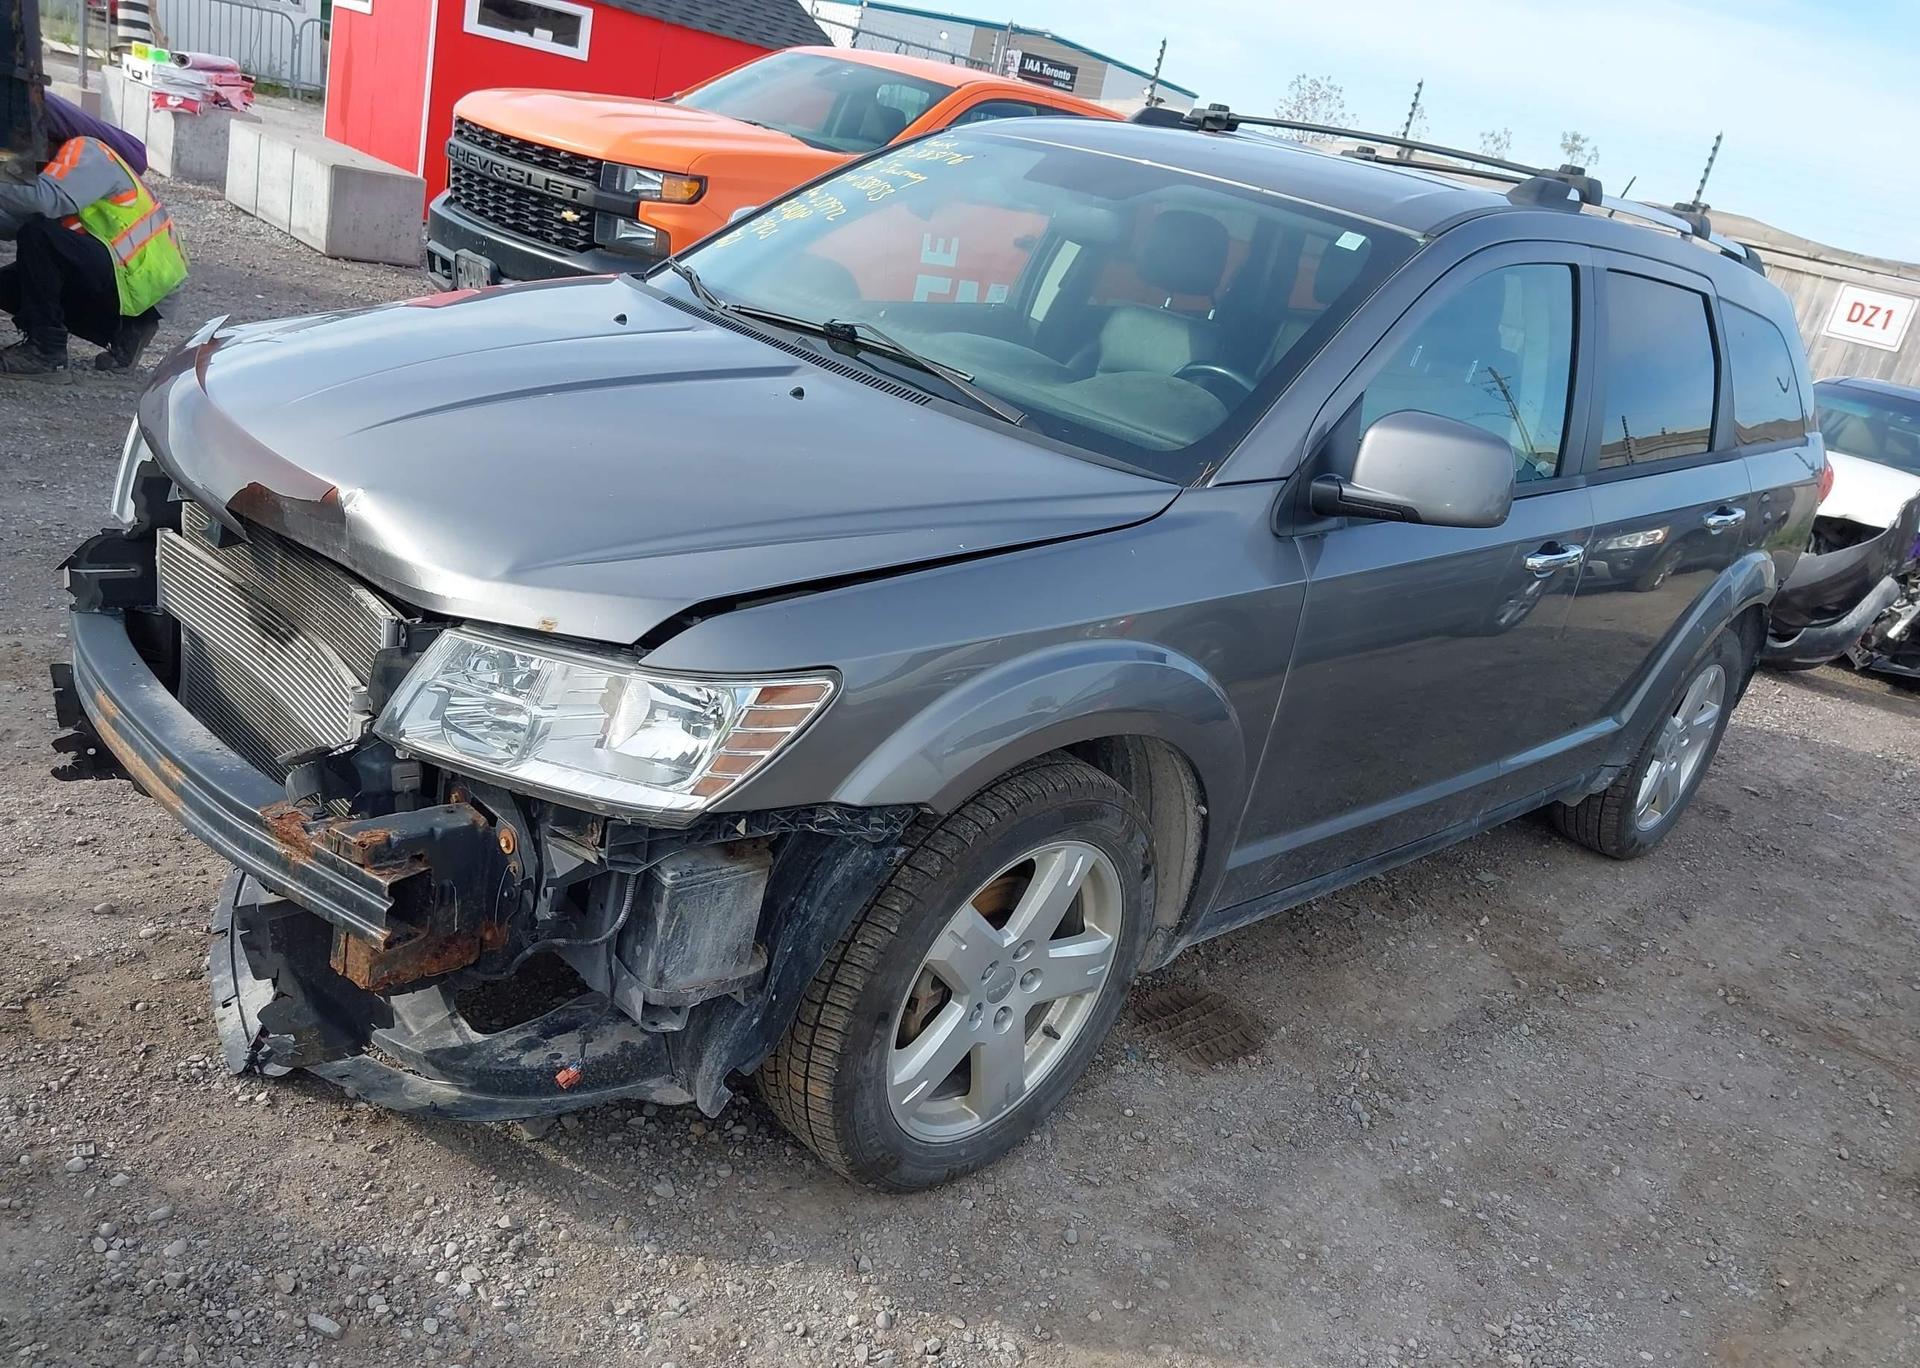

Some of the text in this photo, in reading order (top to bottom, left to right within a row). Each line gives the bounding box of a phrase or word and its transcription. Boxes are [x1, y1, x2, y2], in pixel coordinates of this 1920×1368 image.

[1024, 58, 1072, 81] IAA Toronto
[446, 144, 587, 200] CHEVROLET
[1847, 302, 1894, 330] DZ1
